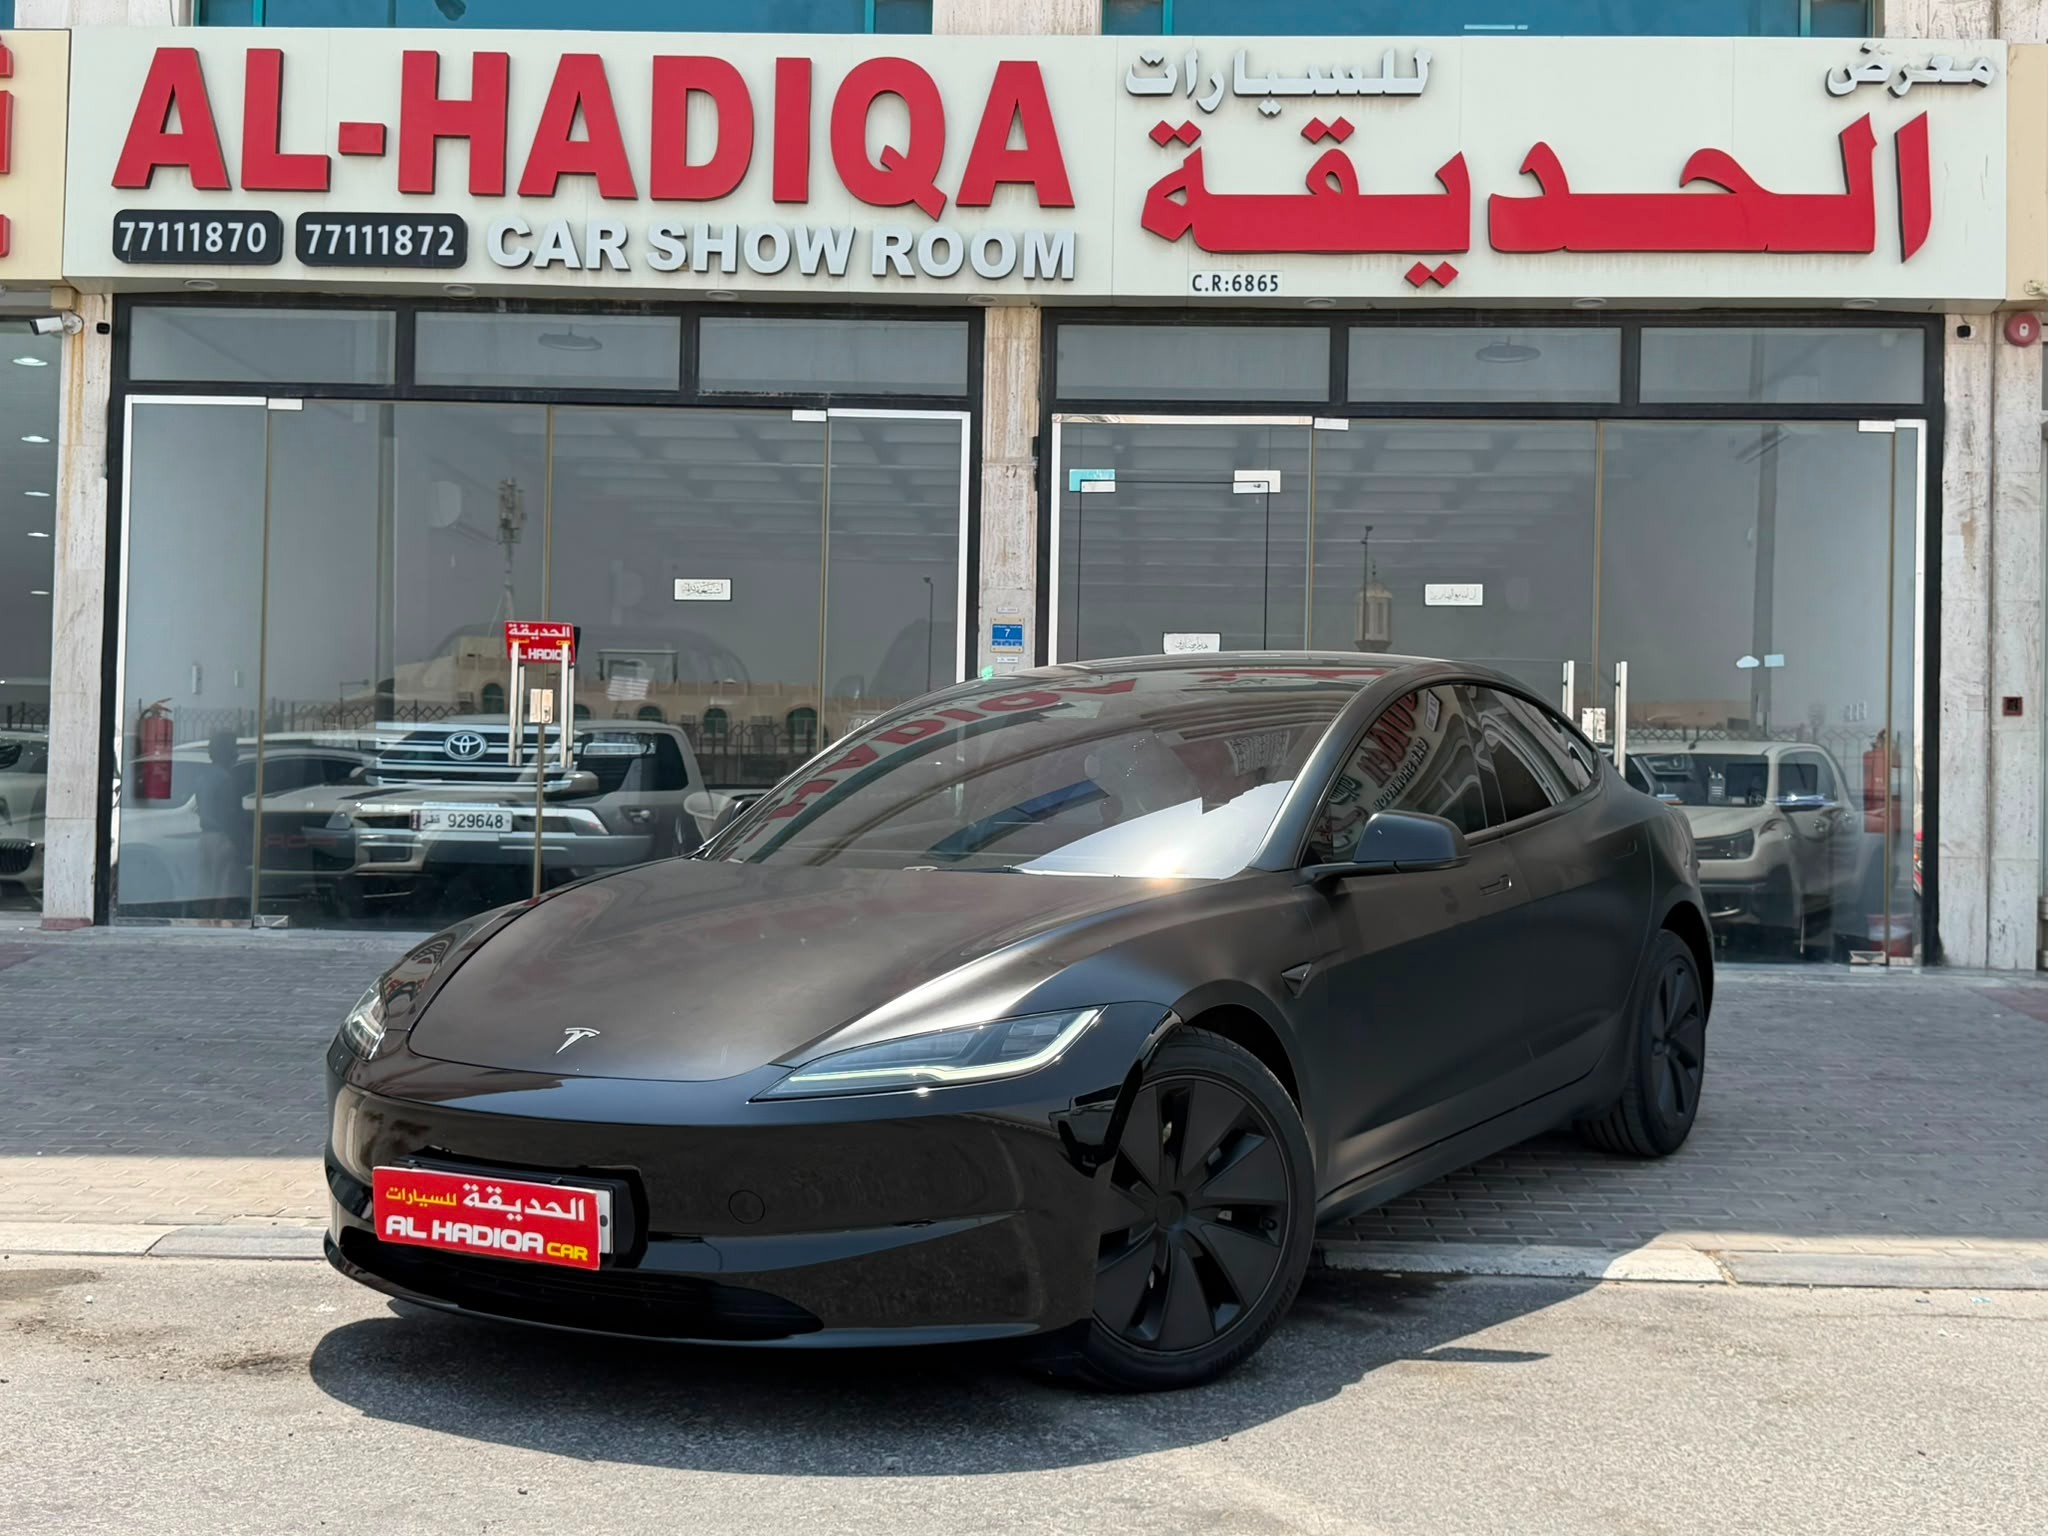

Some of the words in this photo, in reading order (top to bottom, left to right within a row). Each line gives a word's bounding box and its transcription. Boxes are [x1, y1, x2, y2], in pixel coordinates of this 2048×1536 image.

[1126, 48, 1433, 118] للسيارات
[1825, 42, 1997, 99] معرض
[112, 48, 1074, 219] AL-HADIQA
[1141, 112, 1932, 288] الحديقة
[119, 222, 267, 253] 77111870
[305, 224, 455, 256] 77111872
[486, 218, 631, 271] CAR
[646, 221, 855, 277] SHOW
[872, 227, 1075, 281] ROOM
[1192, 274, 1279, 292] C.R:6865
[508, 623, 571, 640] الحديقة
[1004, 628, 1011, 638] 7
[447, 813, 504, 829] 929648
[385, 1187, 458, 1207] للسيارات
[462, 1183, 585, 1222] الحديقة
[386, 1215, 427, 1238] AL
[431, 1221, 544, 1254] HADIQA
[547, 1243, 588, 1261] CAR
